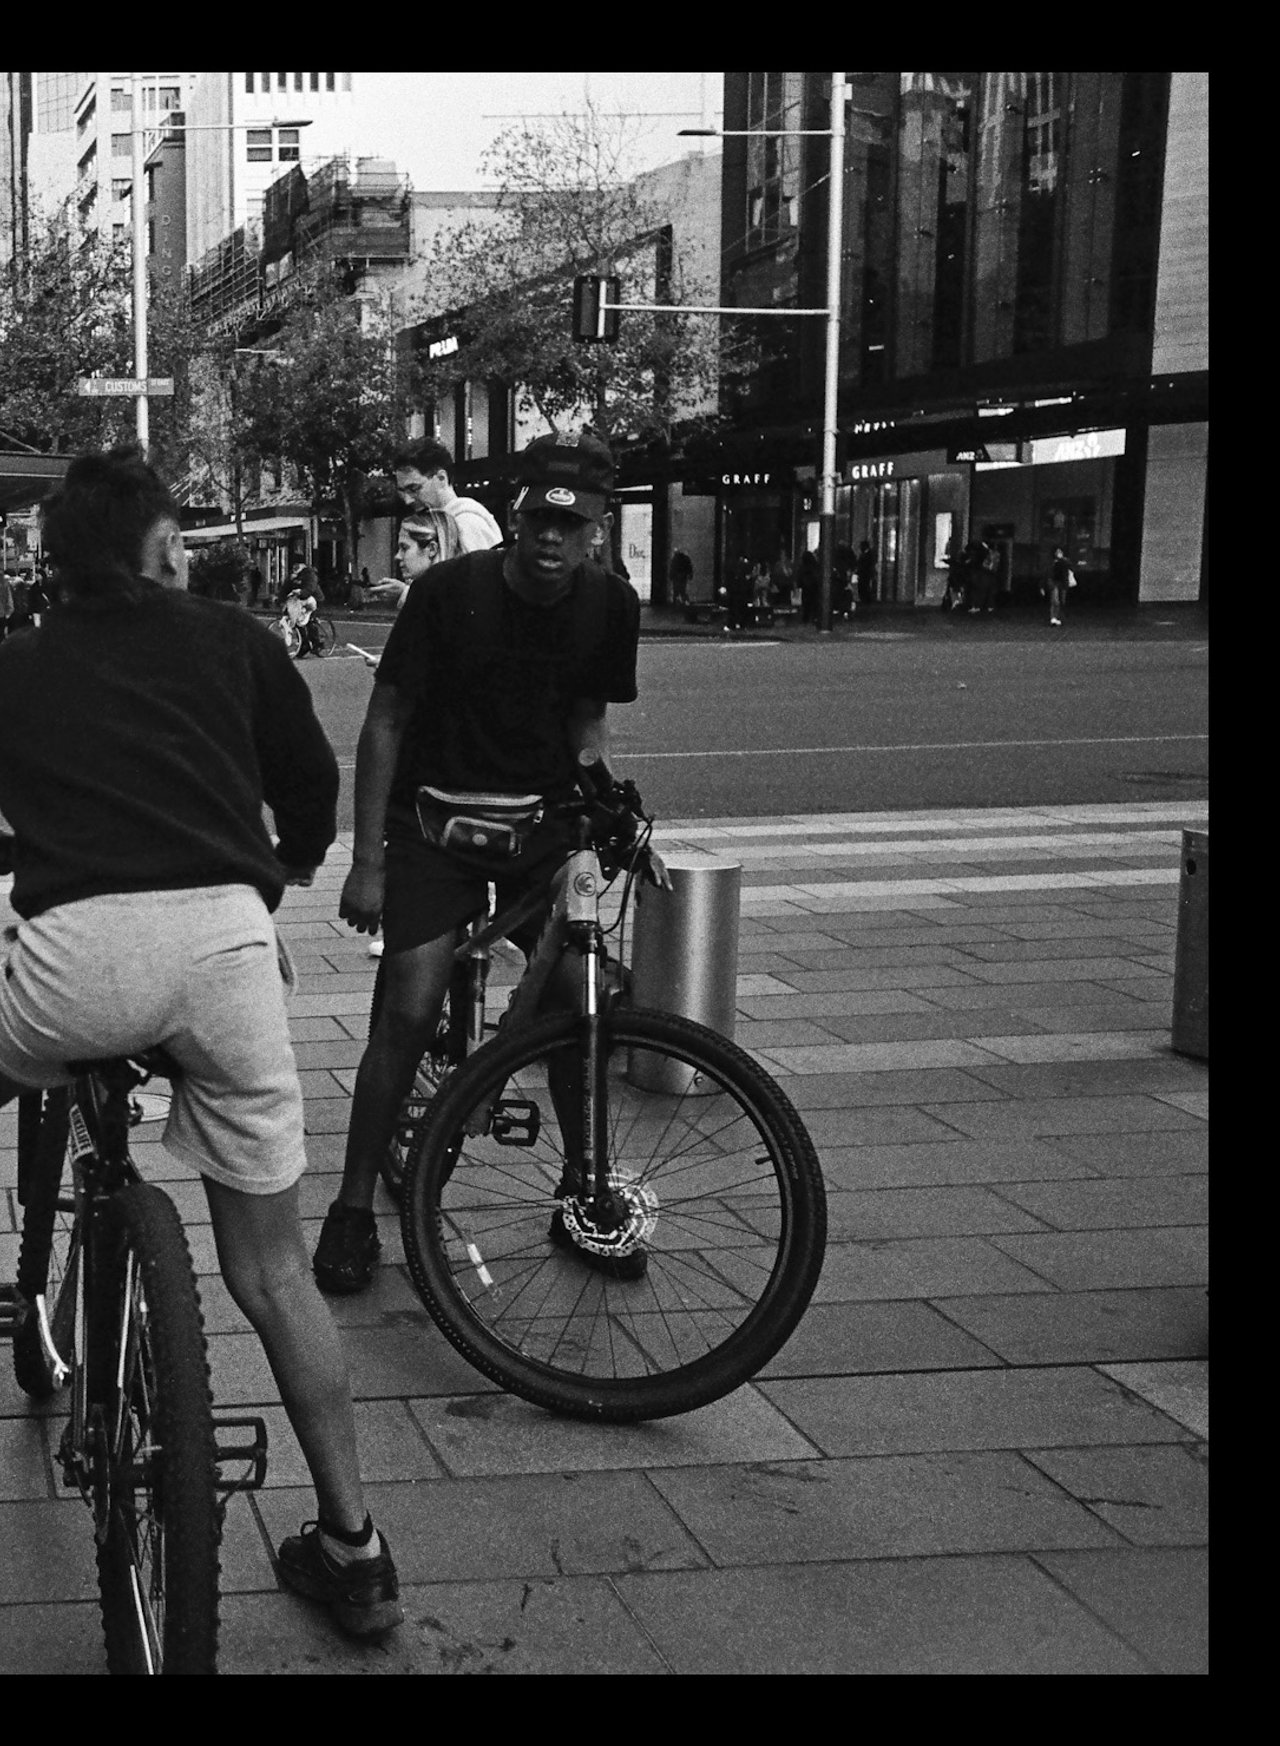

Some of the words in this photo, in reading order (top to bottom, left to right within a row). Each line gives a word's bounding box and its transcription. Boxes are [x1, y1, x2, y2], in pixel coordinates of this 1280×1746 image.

[105, 381, 147, 392] CUSTOMS
[852, 462, 894, 479] GRAFF
[722, 474, 770, 485] GRAFF
